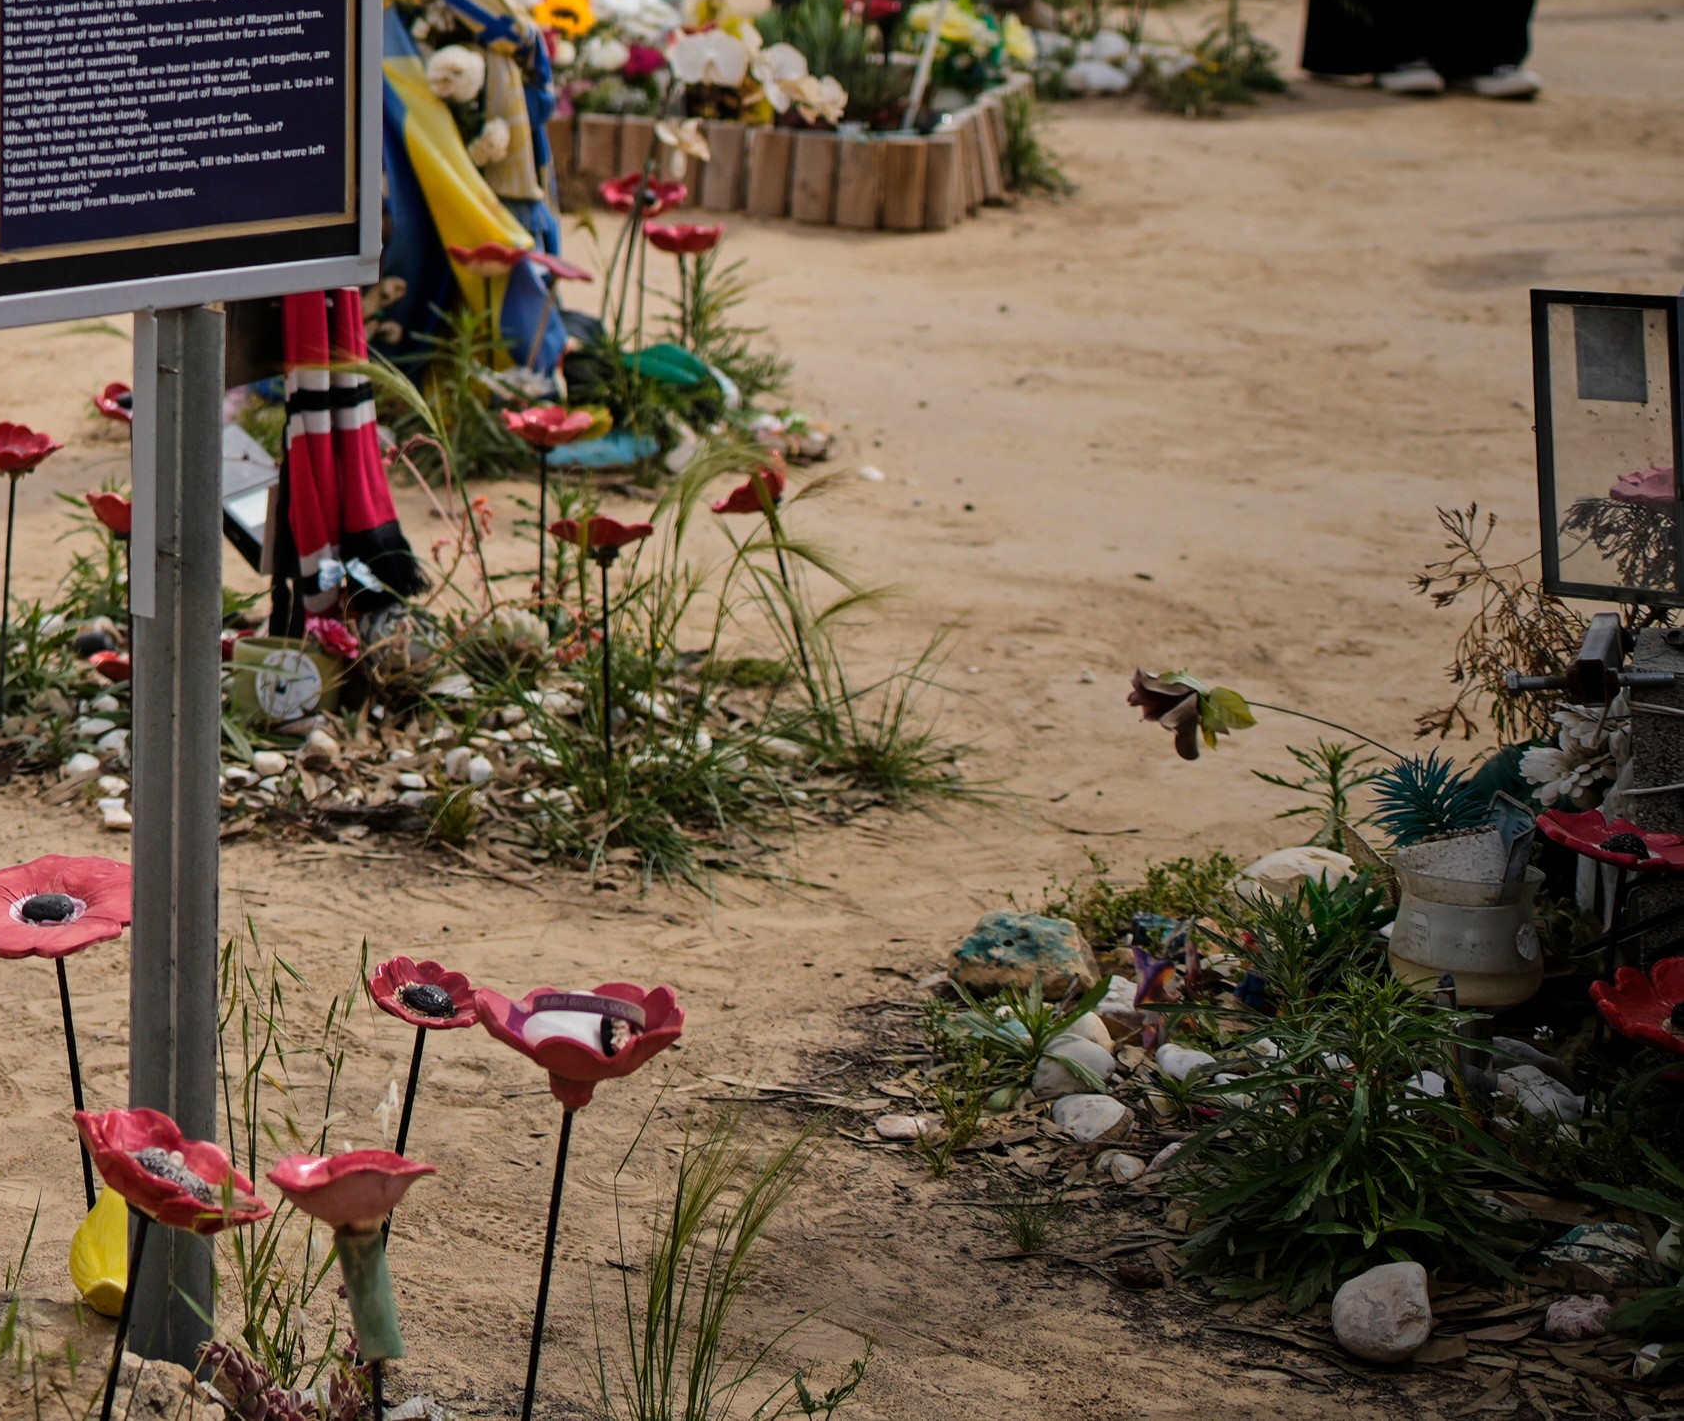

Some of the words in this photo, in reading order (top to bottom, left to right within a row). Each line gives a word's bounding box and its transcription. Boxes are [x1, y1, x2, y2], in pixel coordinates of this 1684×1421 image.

[3, 35, 23, 46] But
[23, 29, 53, 44] every
[53, 32, 74, 42] one
[74, 28, 87, 40] of
[87, 29, 101, 39] us
[102, 26, 125, 37] who
[125, 24, 146, 35] met
[146, 23, 164, 33] her
[165, 21, 184, 32] has
[185, 21, 193, 30] a
[193, 17, 218, 29] little
[218, 16, 233, 27] bit
[233, 14, 245, 26] of
[246, 13, 284, 25] Maayan
[284, 11, 295, 21] in
[2, 134, 33, 146] When
[33, 132, 52, 142] the
[52, 129, 76, 140] hole
[76, 128, 87, 138] is
[88, 125, 119, 137] whole
[152, 120, 172, 130] use
[172, 117, 193, 128] that
[194, 114, 216, 128] part
[216, 113, 231, 124] for
[3, 147, 39, 160] Create
[39, 145, 48, 156] it
[49, 144, 74, 155] from
[75, 141, 96, 152] thin
[114, 137, 138, 148] How
[139, 134, 158, 145] will
[159, 134, 175, 143] we
[175, 130, 208, 142] create
[209, 128, 218, 138] it
[218, 126, 243, 137] from
[243, 123, 263, 135] thin
[264, 121, 283, 133] air?
[3, 163, 8, 174] I
[9, 160, 37, 173] don't
[68, 156, 88, 167] But
[88, 150, 136, 165] Maayan's
[136, 148, 159, 162] part
[2, 205, 28, 216] from
[28, 202, 47, 214] the
[47, 200, 83, 211] eulogy
[83, 197, 108, 207] from
[108, 190, 156, 205] Maayan's
